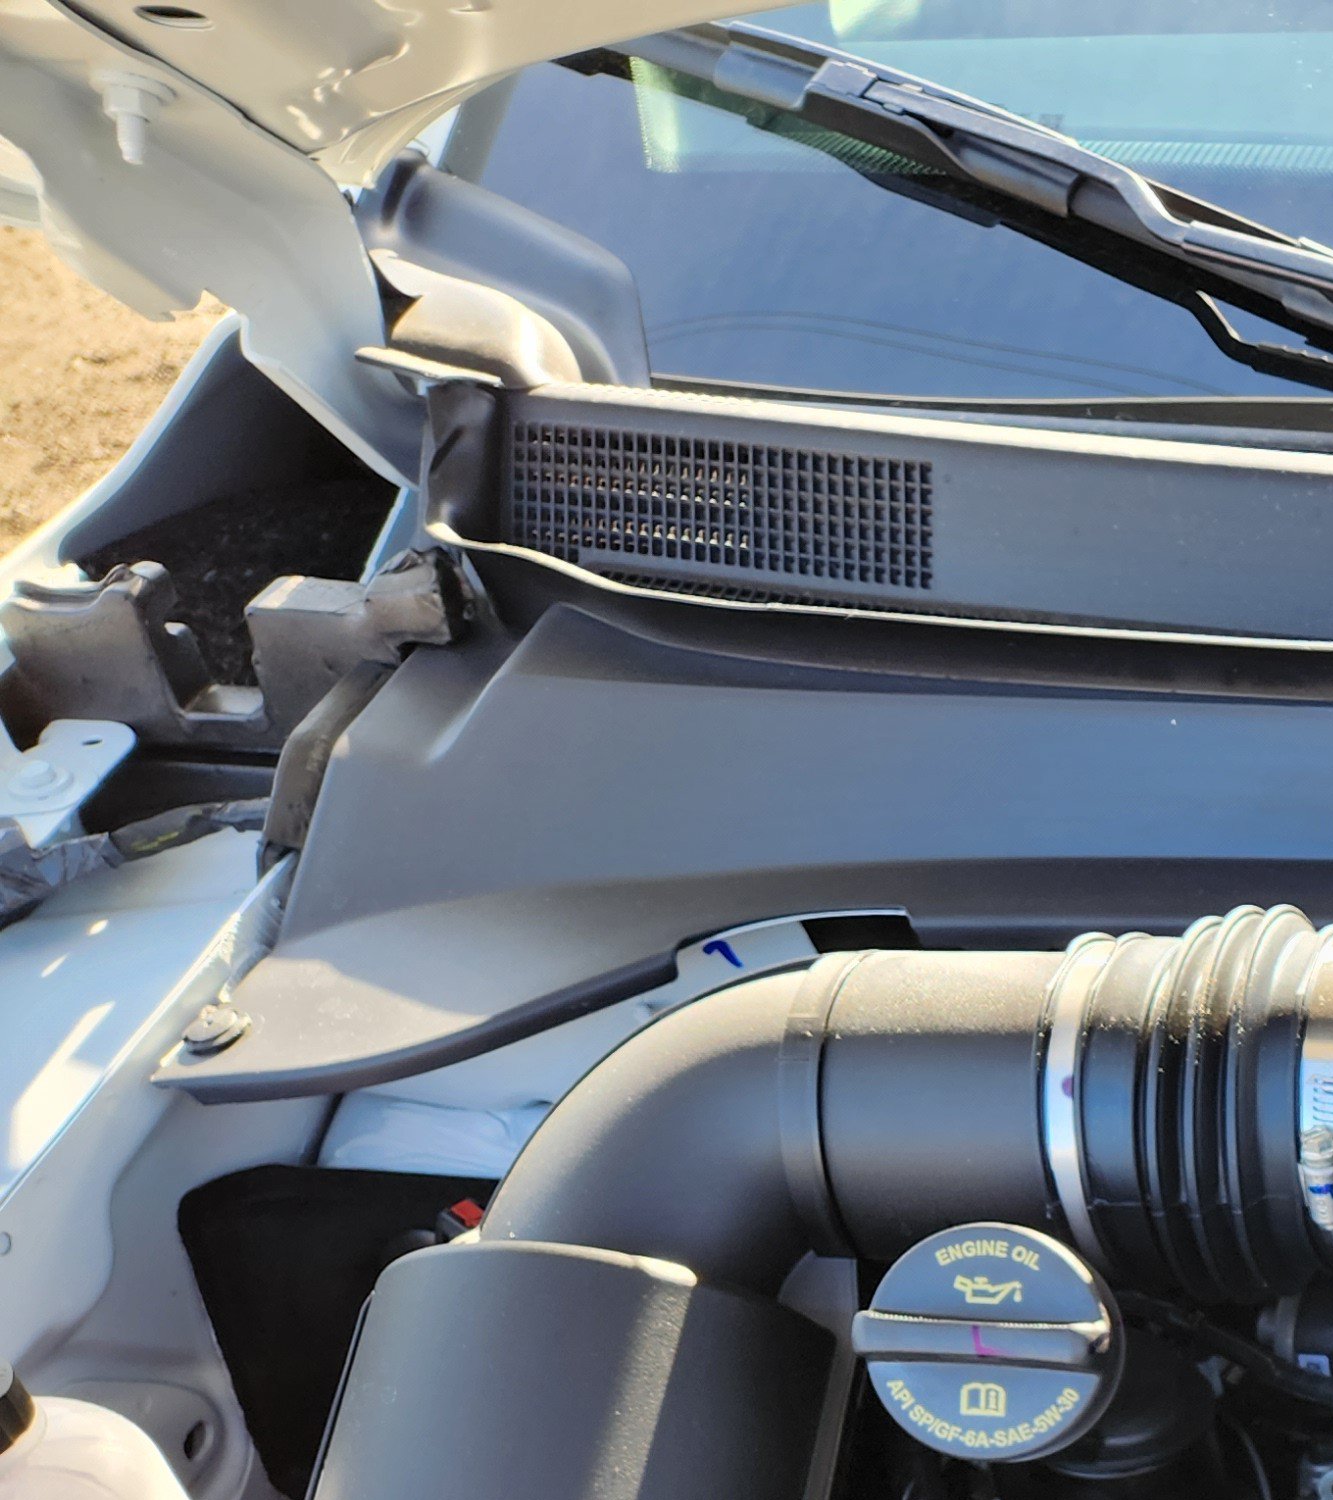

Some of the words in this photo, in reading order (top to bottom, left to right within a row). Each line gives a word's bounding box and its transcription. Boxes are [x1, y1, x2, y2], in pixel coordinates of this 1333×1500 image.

[934, 1240, 1009, 1267] ENGINE
[1011, 1244, 1041, 1271] OIL
[886, 1378, 915, 1411] API
